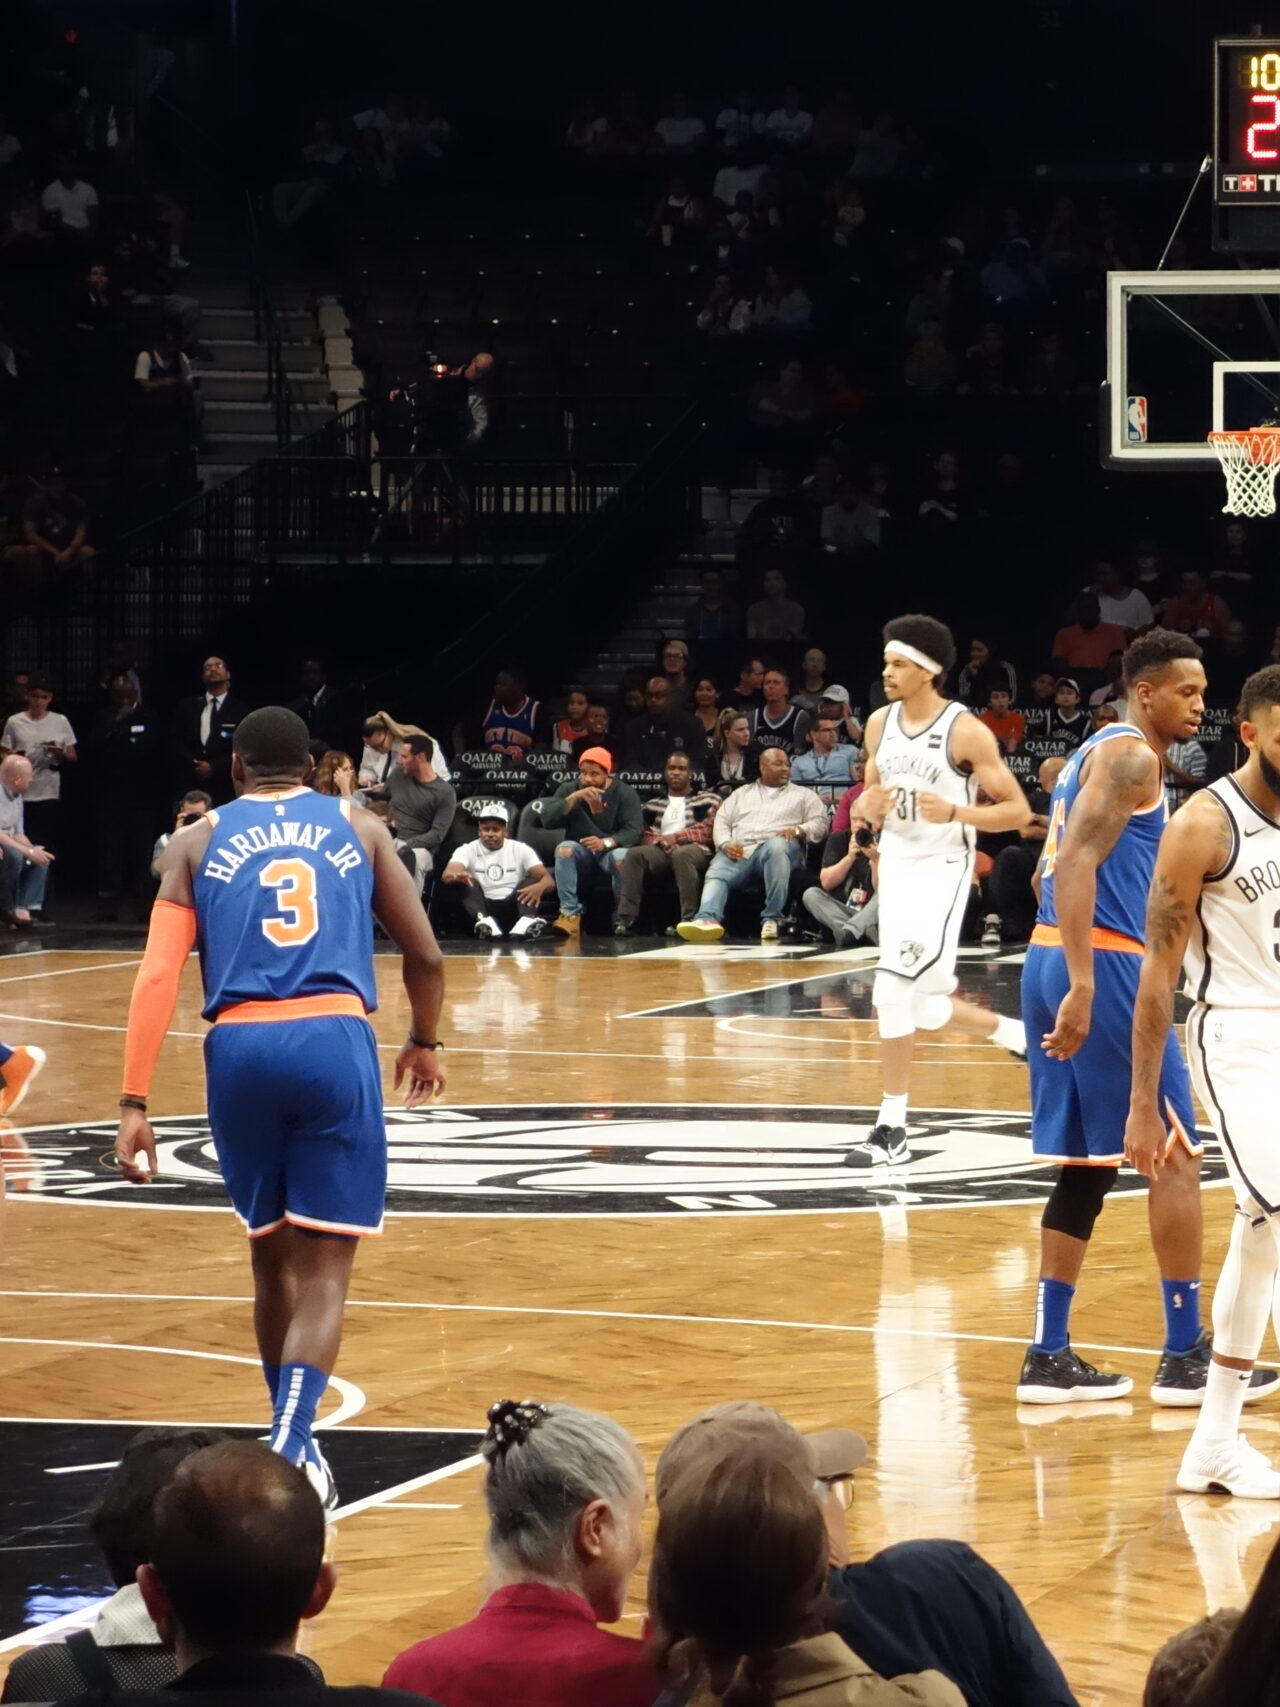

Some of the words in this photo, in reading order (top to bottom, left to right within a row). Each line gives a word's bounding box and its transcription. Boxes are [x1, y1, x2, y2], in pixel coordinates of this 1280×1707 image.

[1203, 708, 1229, 720] QAT
[1025, 741, 1066, 753] QATAR
[461, 752, 502, 765] QATAR
[526, 754, 567, 766] QATAR
[552, 771, 579, 783] QAT
[896, 787, 917, 822] 31
[204, 822, 331, 884] HARDAWAY
[324, 842, 362, 879] JR
[259, 857, 319, 948] 3
